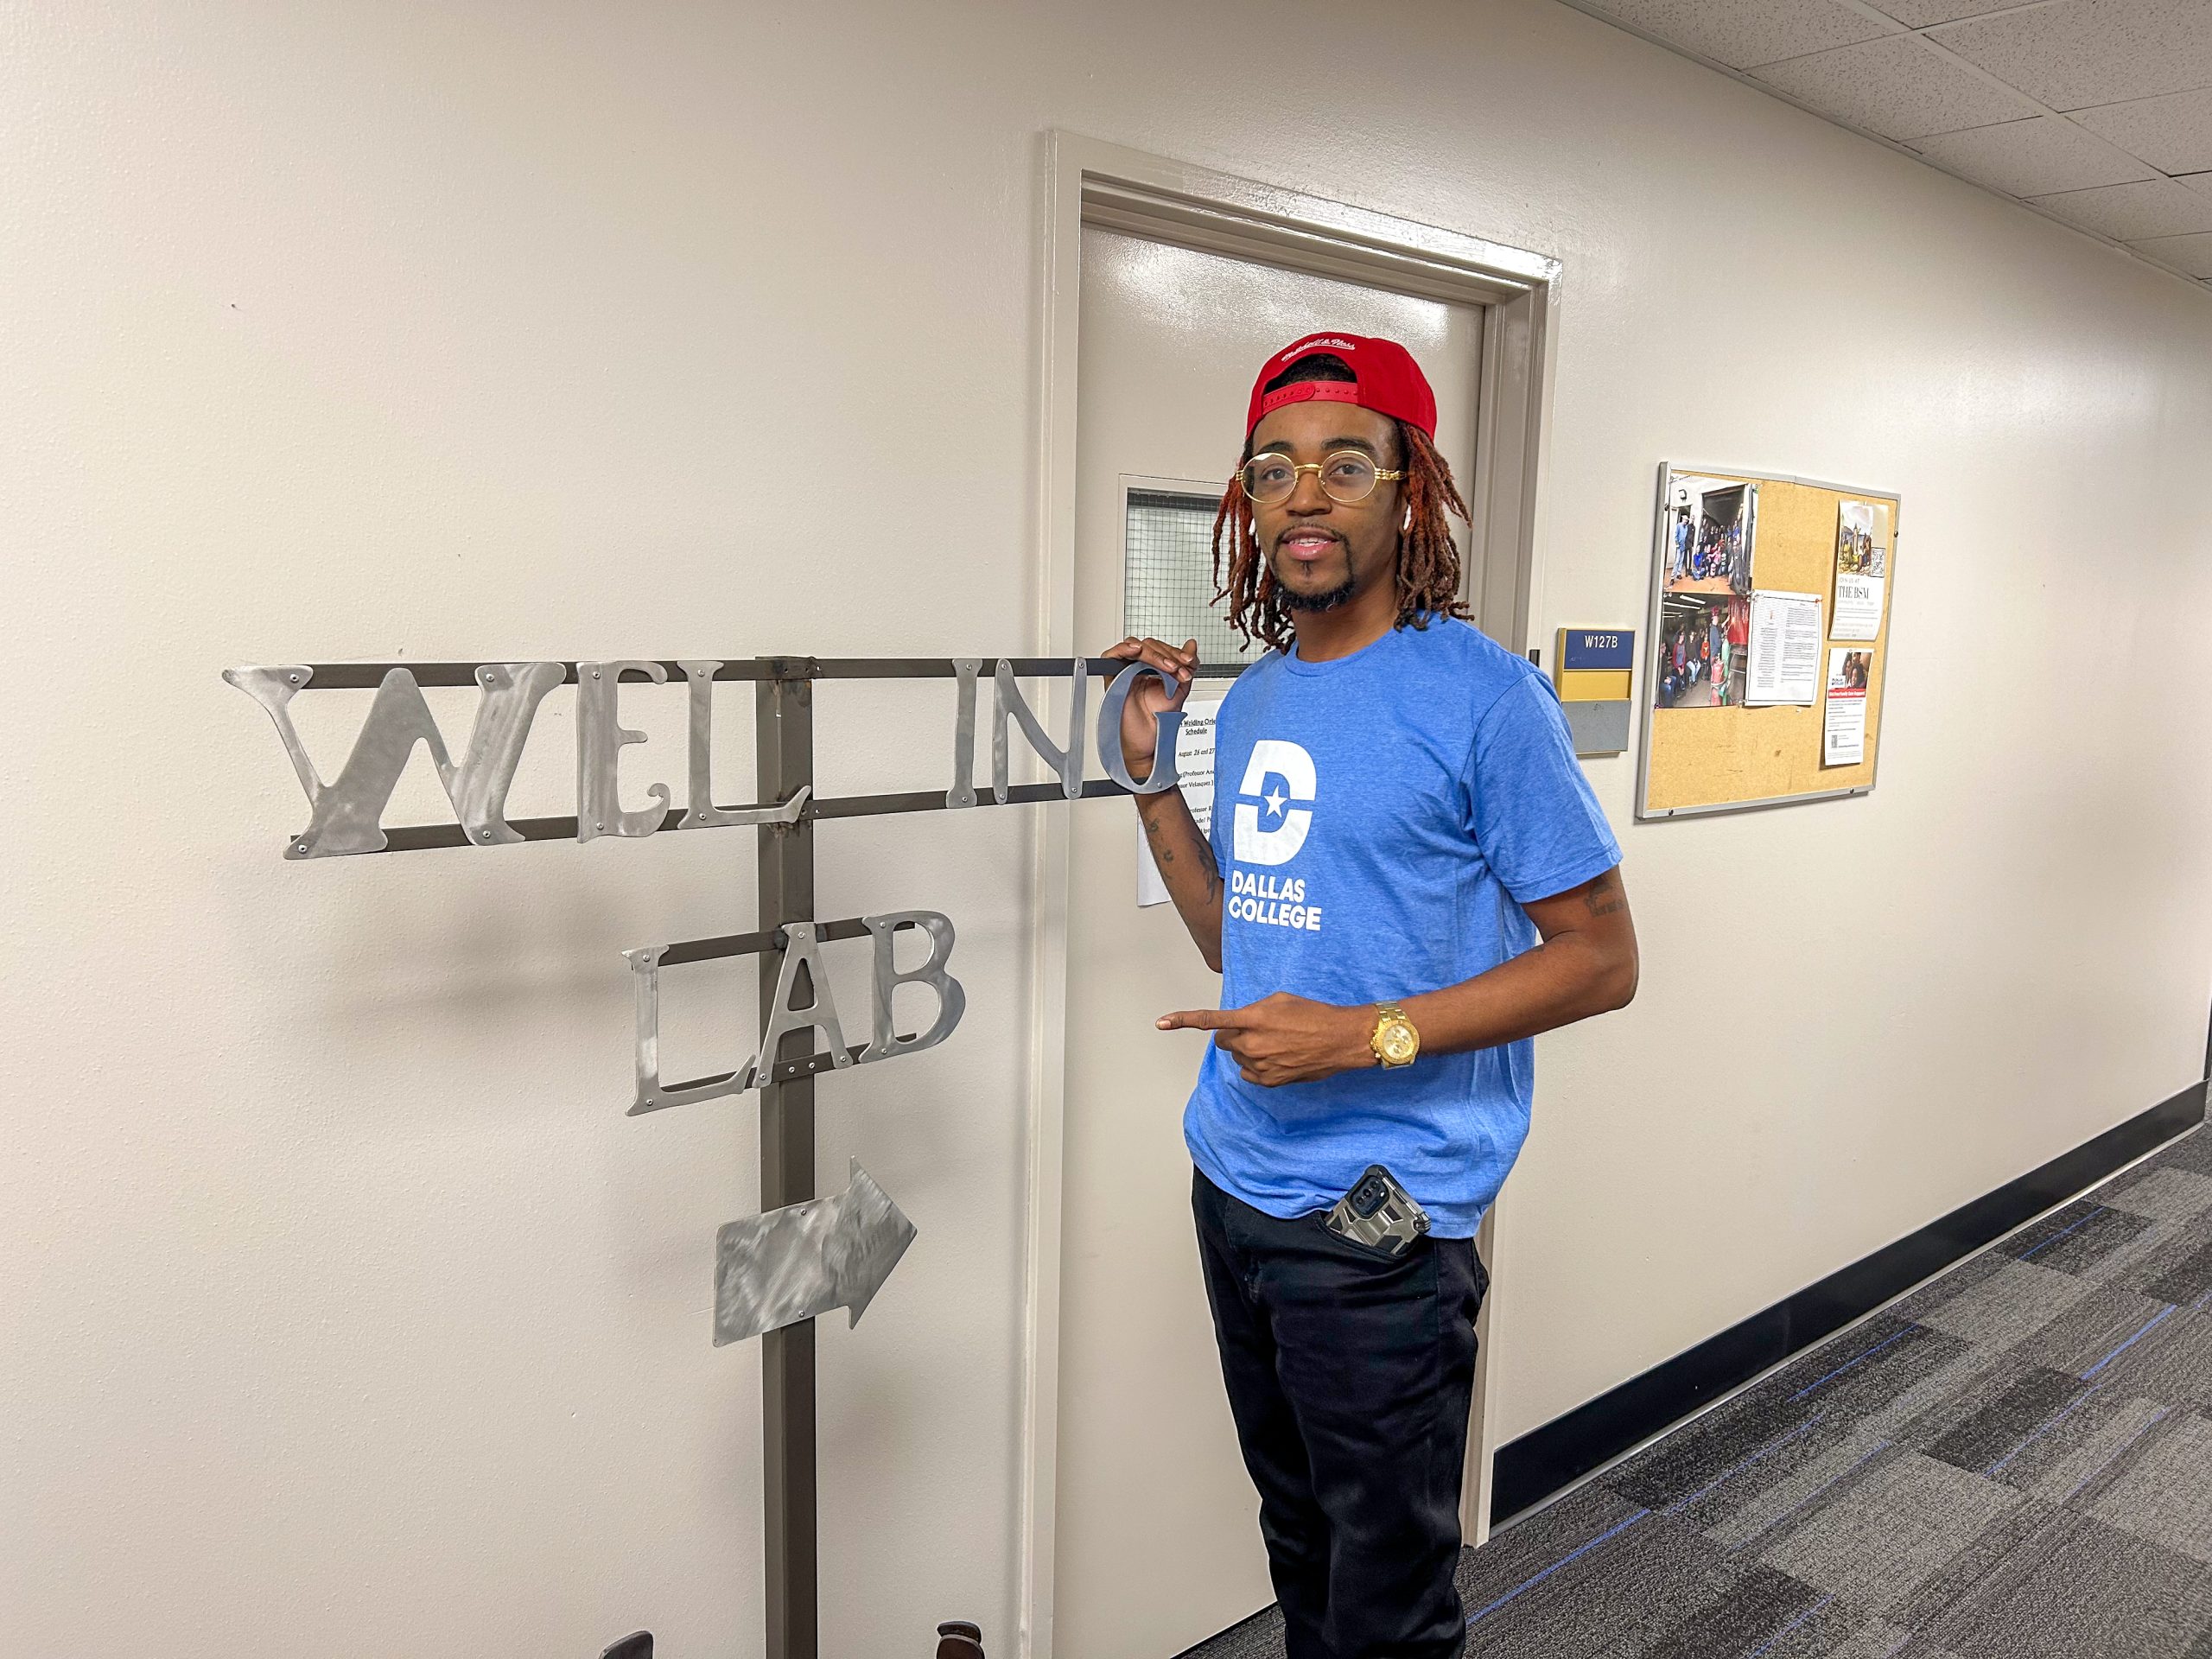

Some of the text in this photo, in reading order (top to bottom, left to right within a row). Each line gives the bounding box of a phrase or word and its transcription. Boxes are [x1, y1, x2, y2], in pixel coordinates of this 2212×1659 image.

[1838, 586, 1853, 598] THE
[1585, 635, 1618, 648] W127B
[1231, 870, 1306, 903] DALLAS
[1228, 895, 1322, 931] COLLEGE
[622, 910, 966, 1116] LAB
